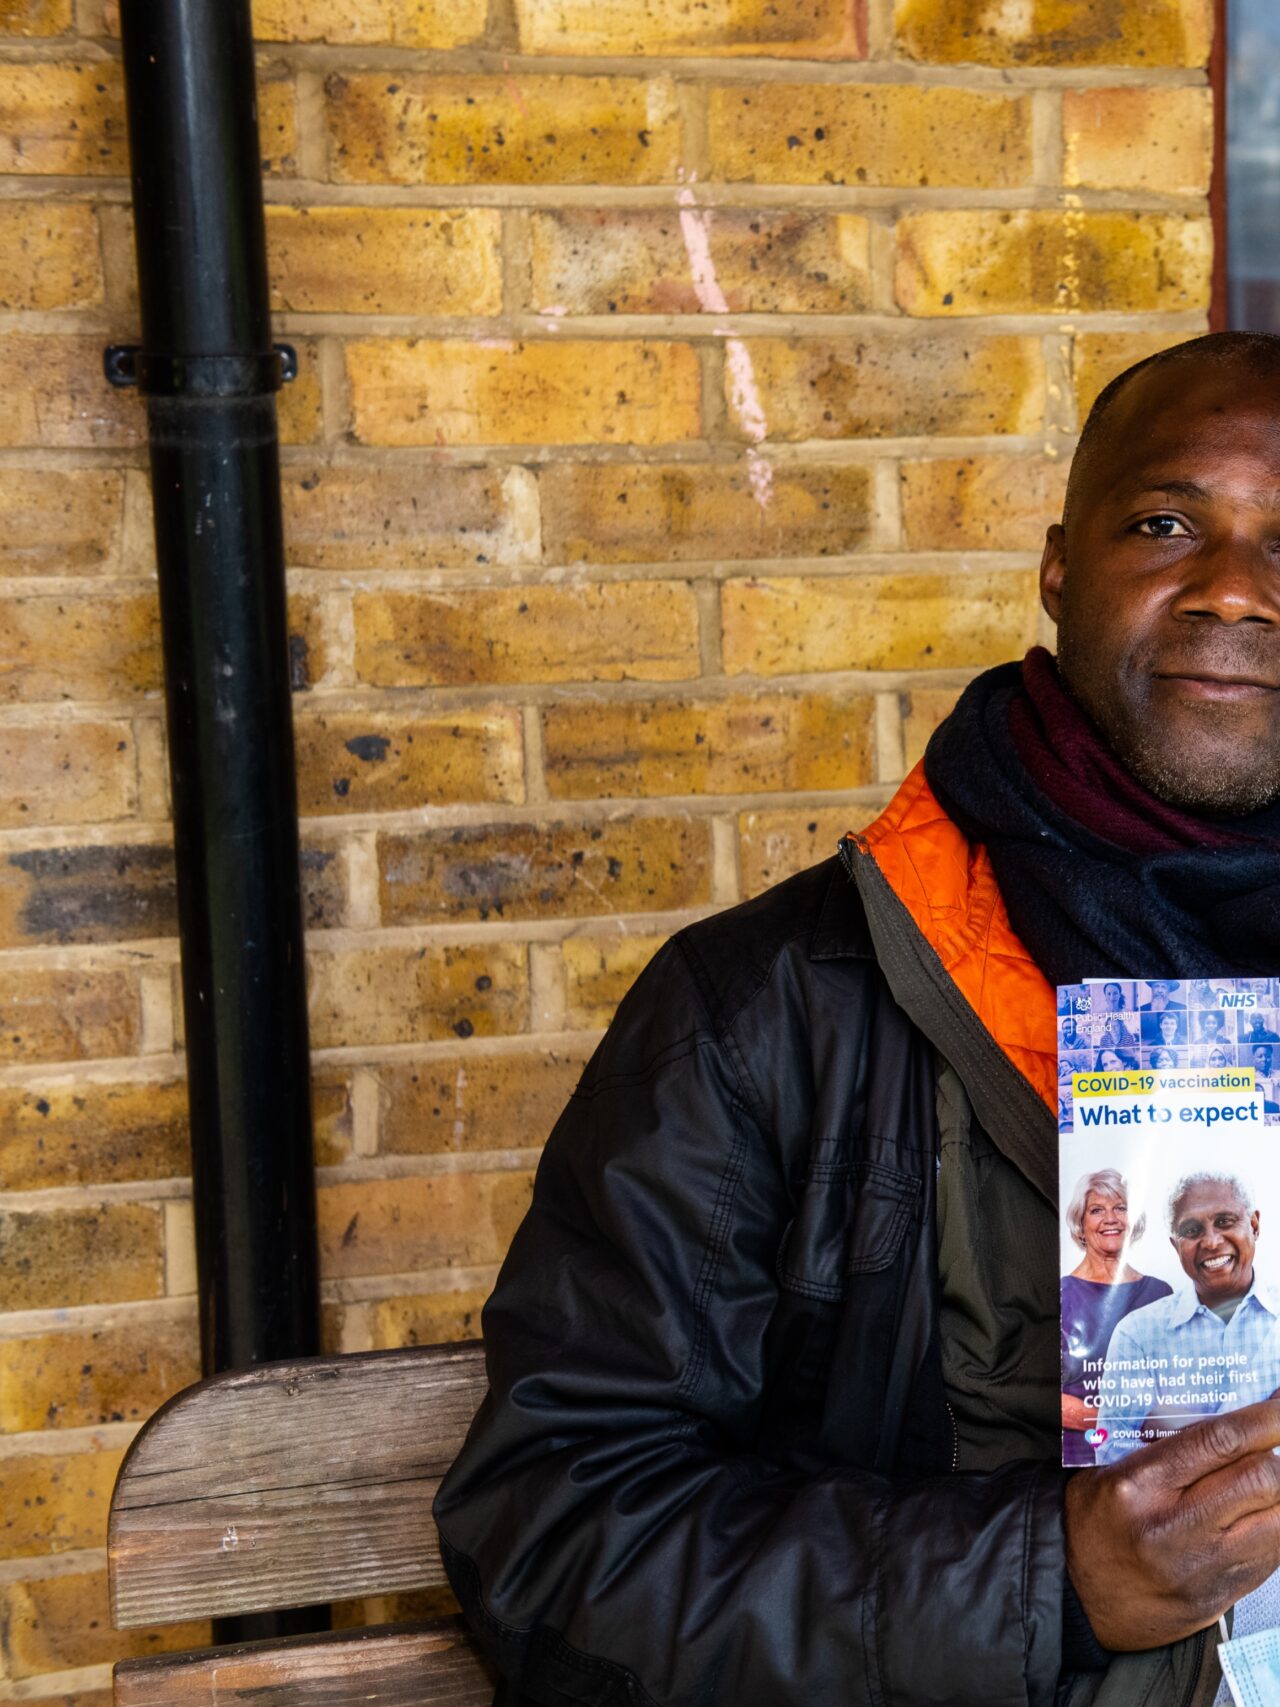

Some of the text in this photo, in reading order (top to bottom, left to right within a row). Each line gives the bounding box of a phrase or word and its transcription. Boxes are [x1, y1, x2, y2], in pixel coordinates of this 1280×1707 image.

[1221, 994, 1256, 1008] NHS
[1106, 1012, 1135, 1020] Health
[1076, 1024, 1112, 1034] England
[1078, 1074, 1250, 1092] COVID-19 vaccination
[1080, 1101, 1258, 1127] What to expect
[1083, 1352, 1248, 1372] Information for people
[1083, 1370, 1258, 1390] who have had their first
[1084, 1390, 1238, 1408] COVID-19 vaccination
[1113, 1430, 1154, 1438] COVID-19
